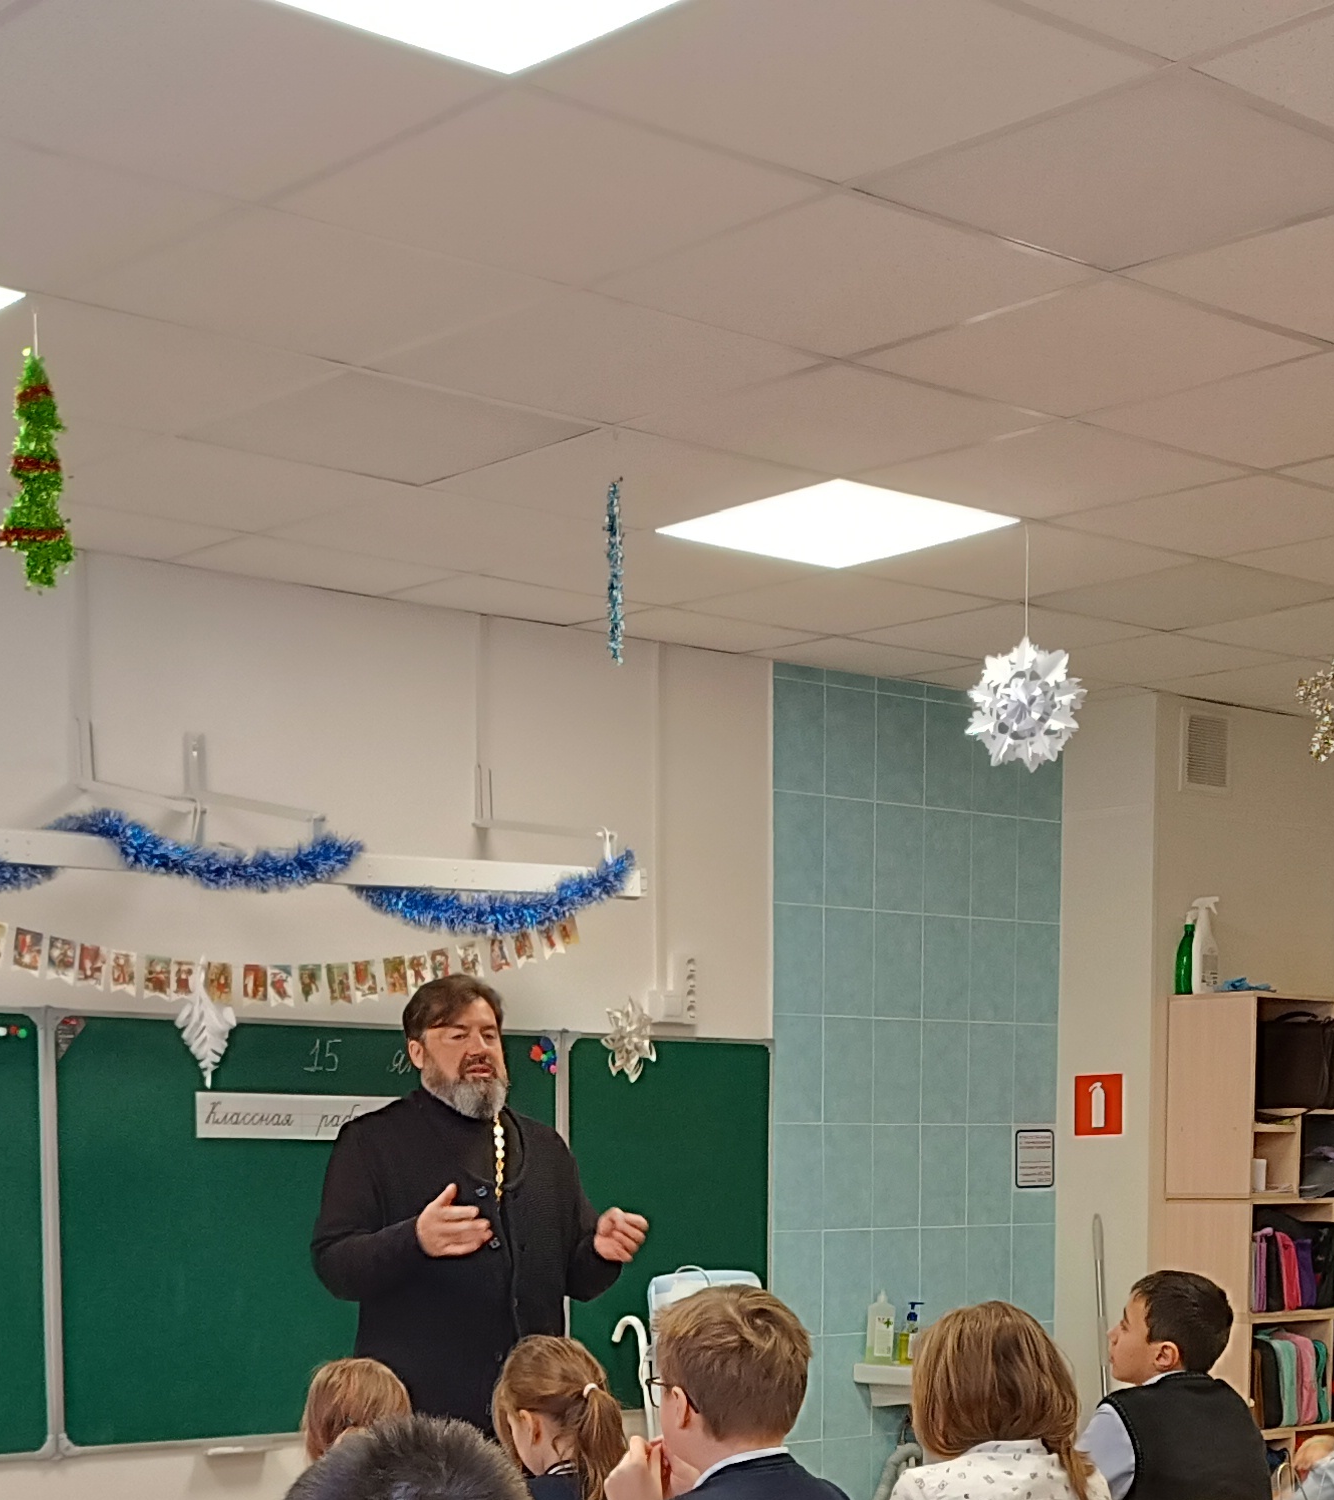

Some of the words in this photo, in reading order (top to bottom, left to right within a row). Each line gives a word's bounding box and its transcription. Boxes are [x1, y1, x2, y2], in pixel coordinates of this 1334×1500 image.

[303, 1038, 342, 1073] 15
[387, 1049, 412, 1075] я
[204, 1101, 295, 1127] Классная
[315, 1104, 361, 1137] раб
